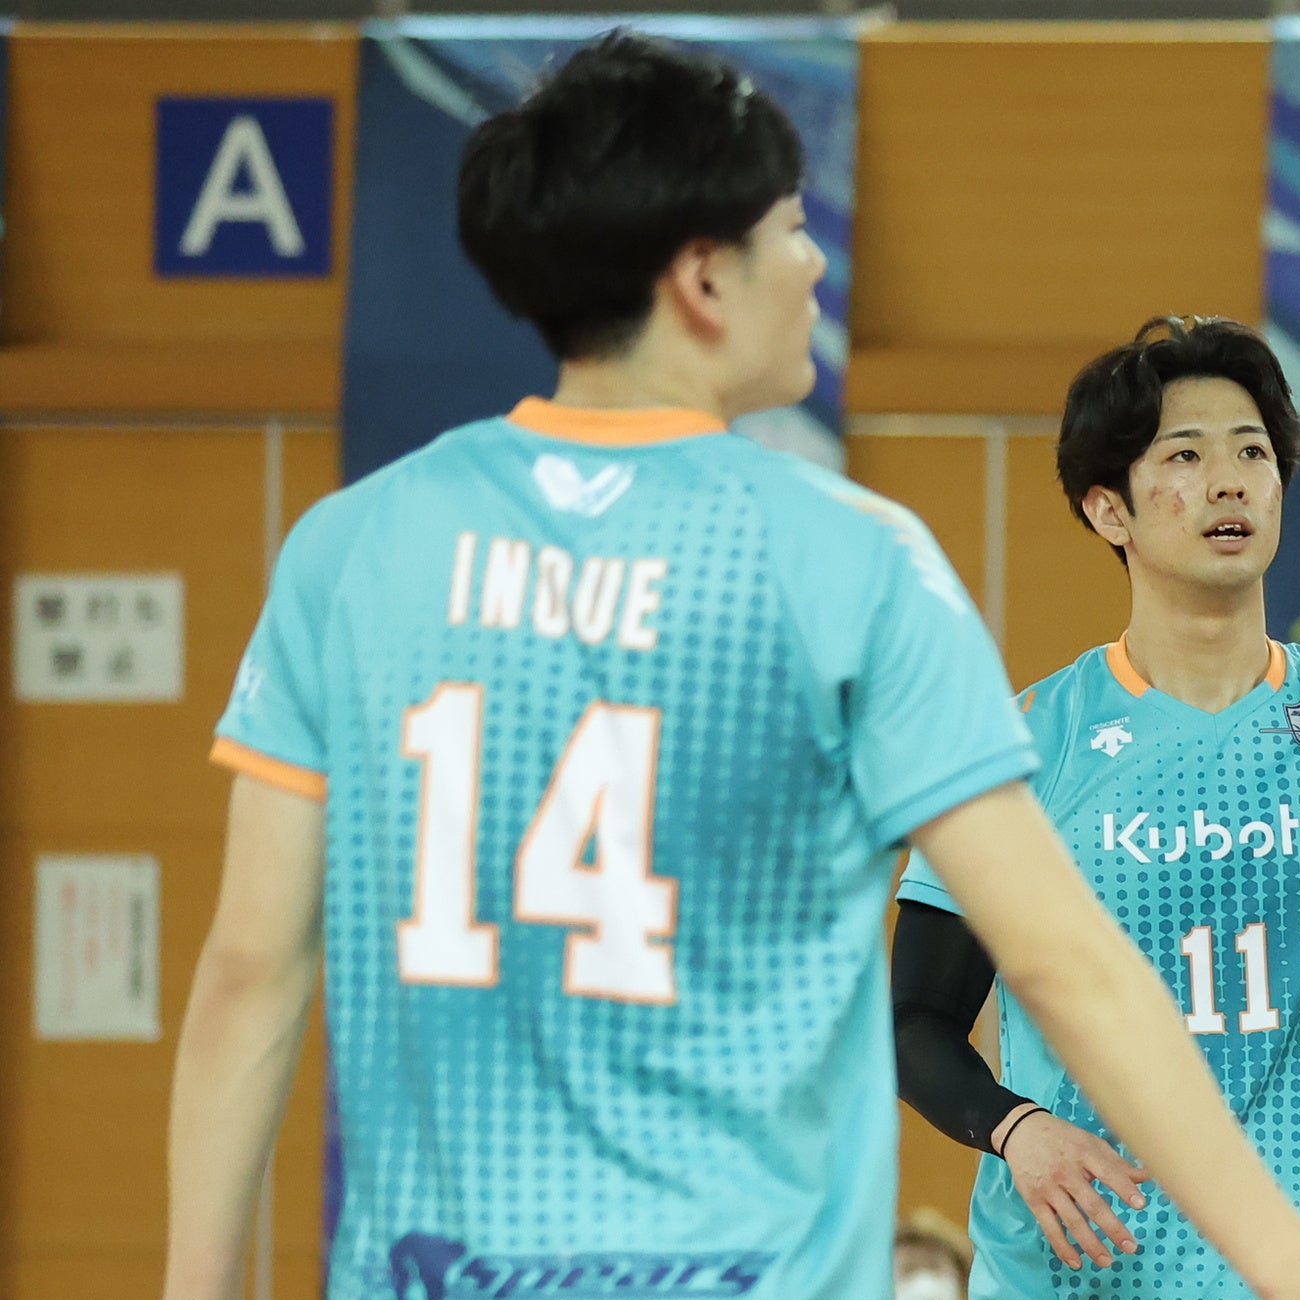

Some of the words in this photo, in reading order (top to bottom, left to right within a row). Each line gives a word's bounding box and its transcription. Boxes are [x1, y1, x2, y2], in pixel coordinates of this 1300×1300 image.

[178, 115, 306, 257] A
[447, 530, 668, 651] INOUE
[396, 680, 680, 1007] 14
[1180, 922, 1281, 1035] 11
